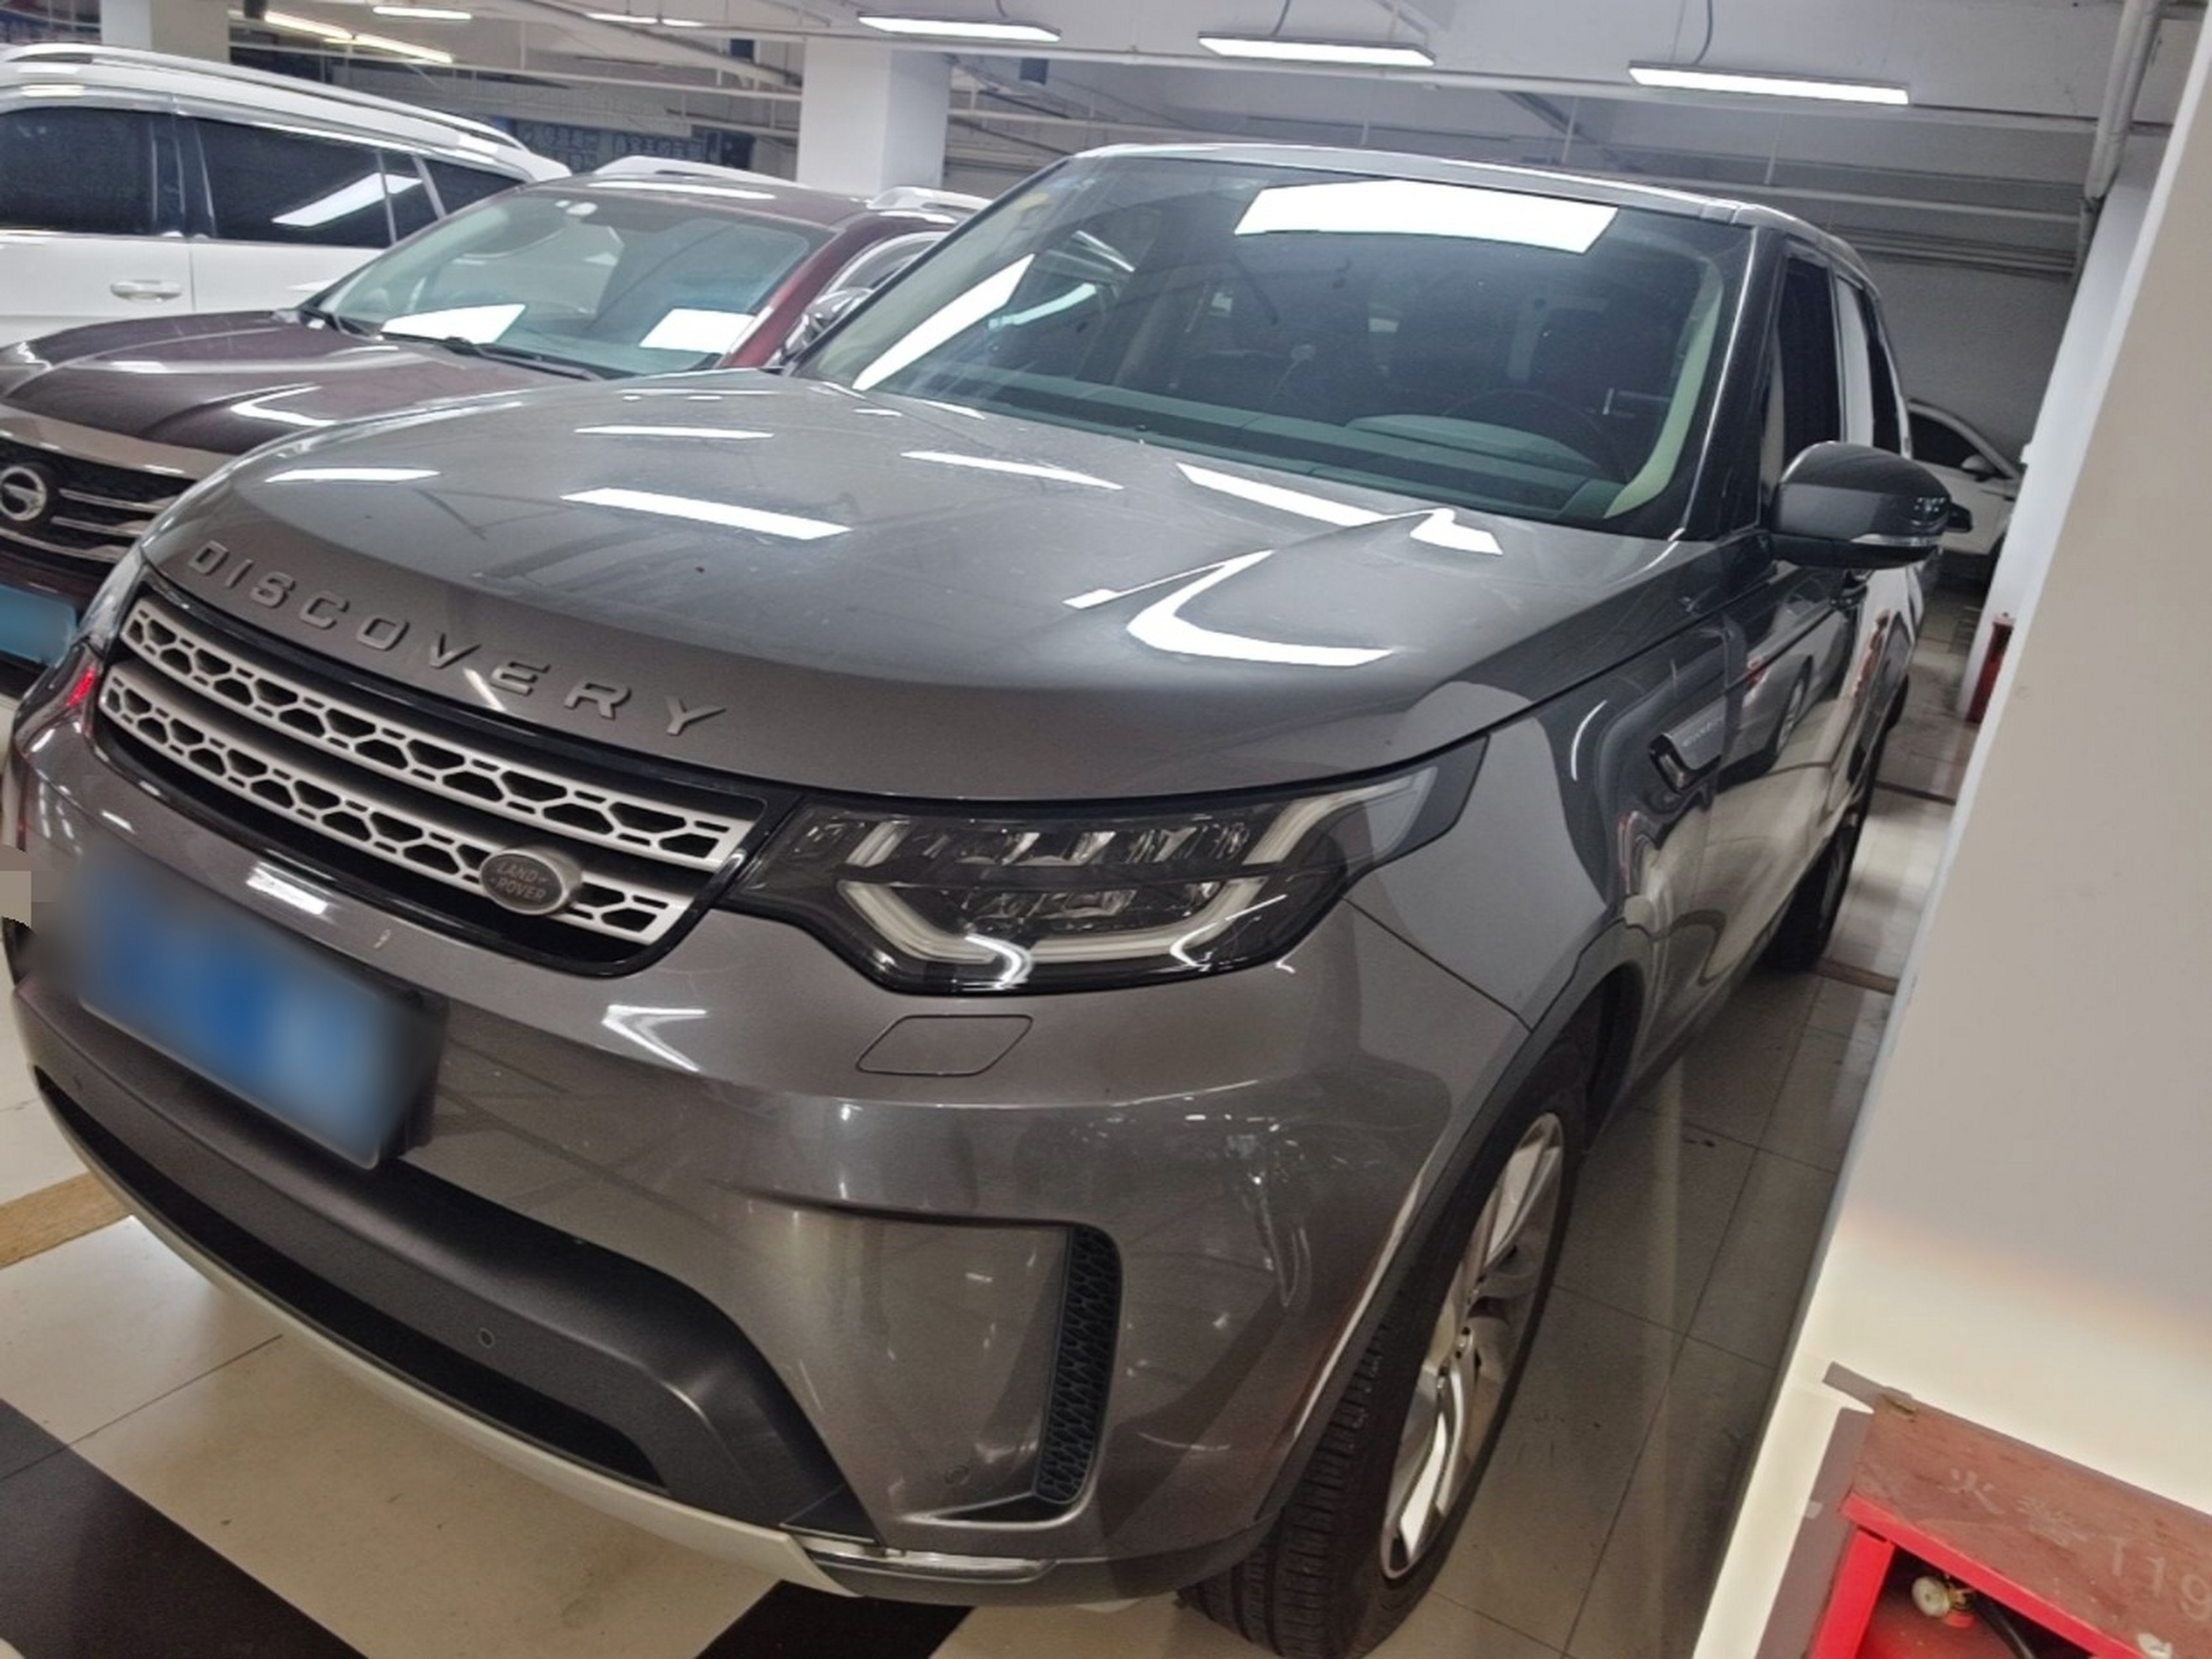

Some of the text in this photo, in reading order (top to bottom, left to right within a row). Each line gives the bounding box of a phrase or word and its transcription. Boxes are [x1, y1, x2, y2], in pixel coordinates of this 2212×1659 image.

[188, 539, 726, 737] DISCOVERY
[497, 862, 539, 883] LAND
[496, 877, 547, 903] ROVER
